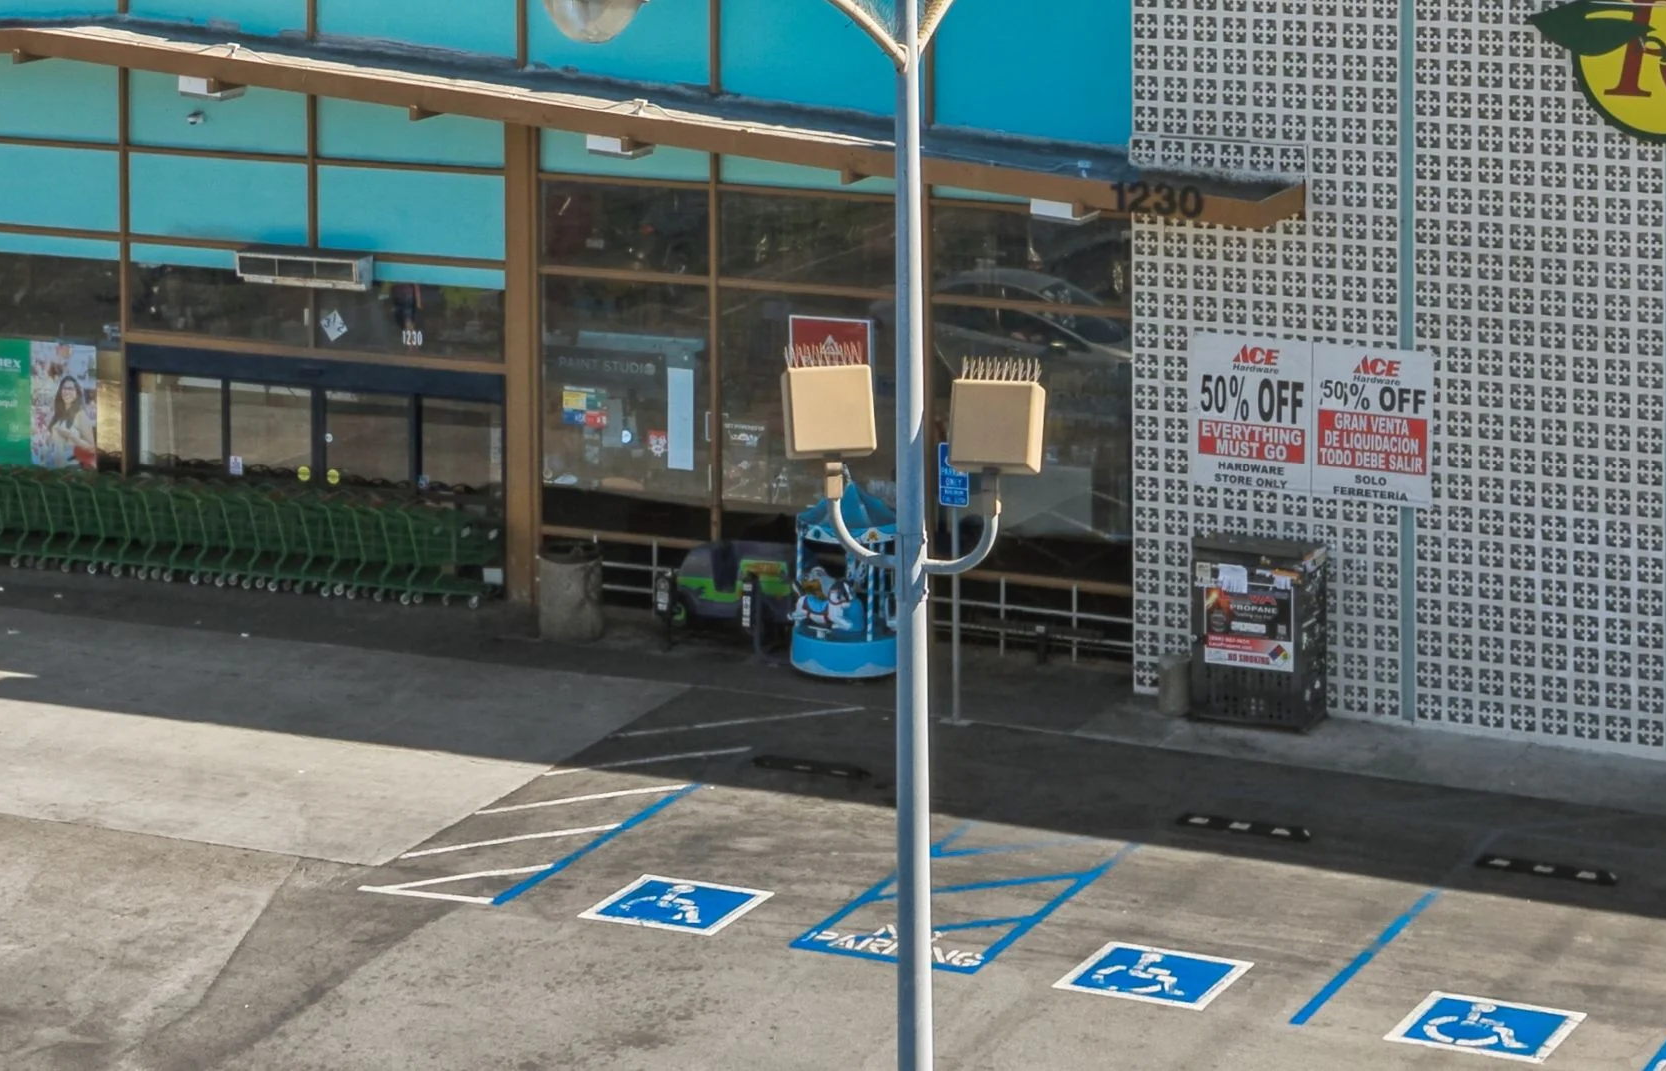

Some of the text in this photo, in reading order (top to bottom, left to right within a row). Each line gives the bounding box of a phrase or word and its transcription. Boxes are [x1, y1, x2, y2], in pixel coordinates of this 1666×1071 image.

[1110, 180, 1203, 218] 1230
[402, 330, 423, 346] 1230
[558, 356, 599, 370] PAINT
[1233, 343, 1280, 365] ACE
[1233, 363, 1279, 375] Hardware
[1353, 355, 1401, 377] ACE
[1353, 374, 1401, 386] Hardware
[1200, 374, 1304, 425] 50% OFF
[1379, 386, 1426, 414] OFF
[1201, 421, 1302, 446] EVERYTHING
[1334, 413, 1409, 436] GRAN VENTA
[1324, 431, 1340, 448] DE
[1216, 439, 1287, 461] MUST GO
[1218, 462, 1284, 476] HARDWARE
[1320, 447, 1423, 473] TODO DEBE SALIR
[1214, 473, 1288, 489] STORE ONLY
[1355, 475, 1387, 487] SOLO
[1333, 486, 1408, 502] FERRETERÍA
[1229, 603, 1278, 615] PROPANE
[802, 931, 985, 967] PARNG
